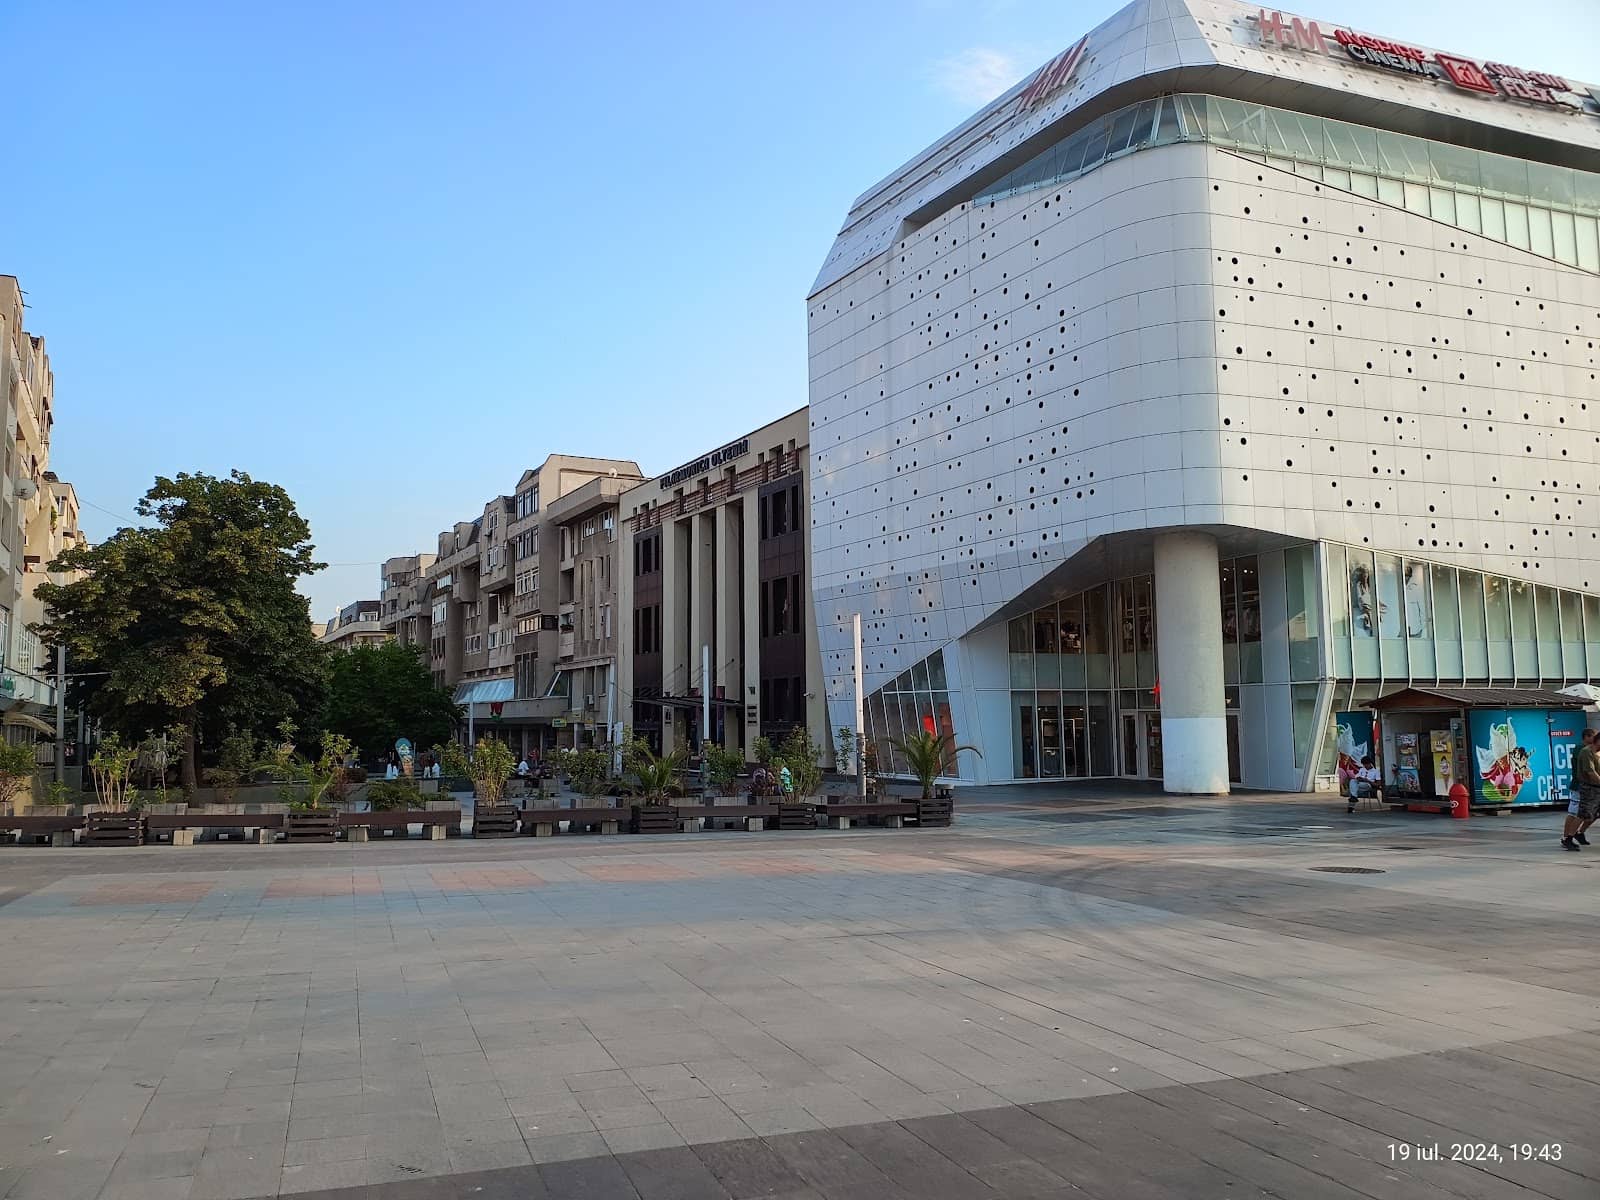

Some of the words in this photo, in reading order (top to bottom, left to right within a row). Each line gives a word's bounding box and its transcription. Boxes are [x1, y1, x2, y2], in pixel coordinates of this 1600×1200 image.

[1334, 29, 1425, 63] INSPIRE
[1347, 43, 1440, 79] CINEMA
[1537, 774, 1573, 801] CRE
